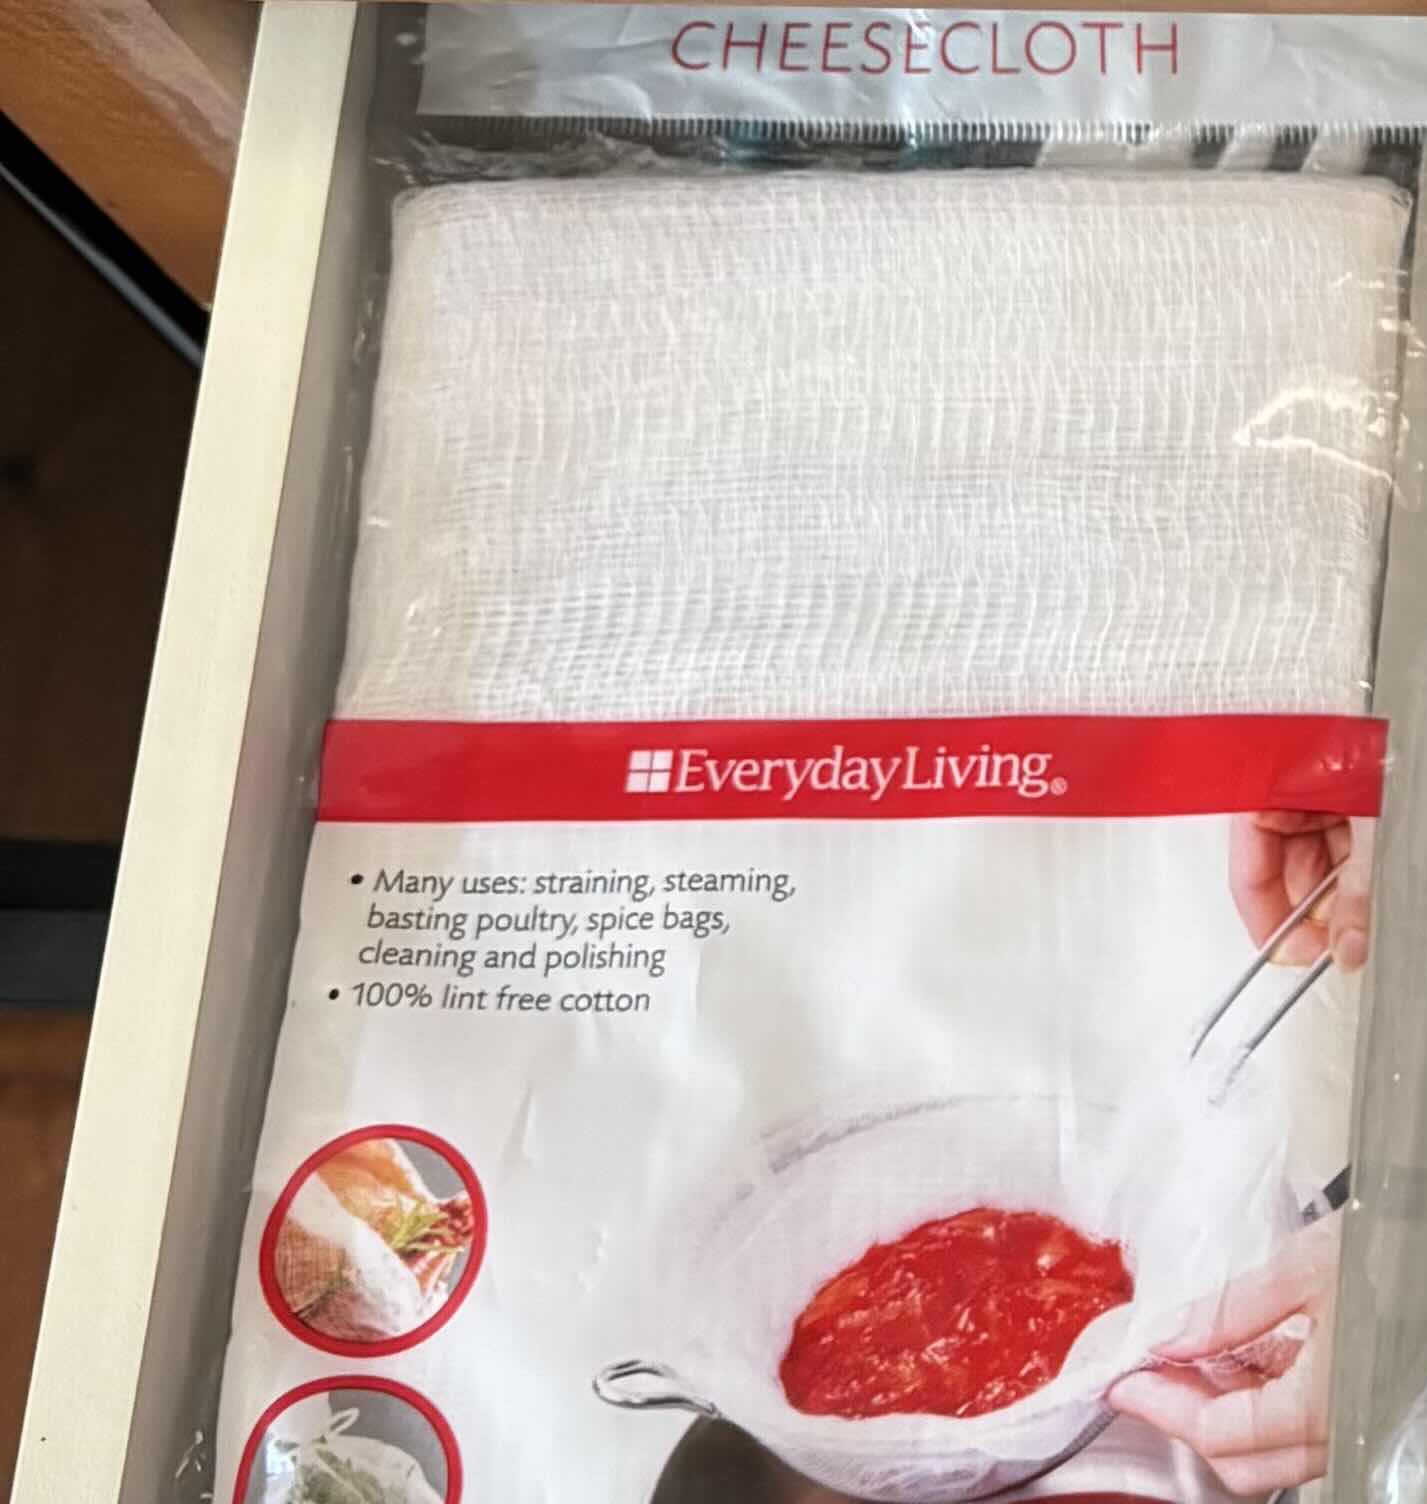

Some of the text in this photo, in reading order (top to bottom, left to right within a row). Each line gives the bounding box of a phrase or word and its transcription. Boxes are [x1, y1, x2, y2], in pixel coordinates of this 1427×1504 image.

[671, 21, 1179, 75] CHEESECLOTH
[372, 867, 797, 903] Many uses: straining, steaming,
[366, 904, 731, 939] basting poultry, spice bags,
[357, 940, 667, 978] cleaning and polishing
[351, 982, 651, 1013] 100% lint free cotton
